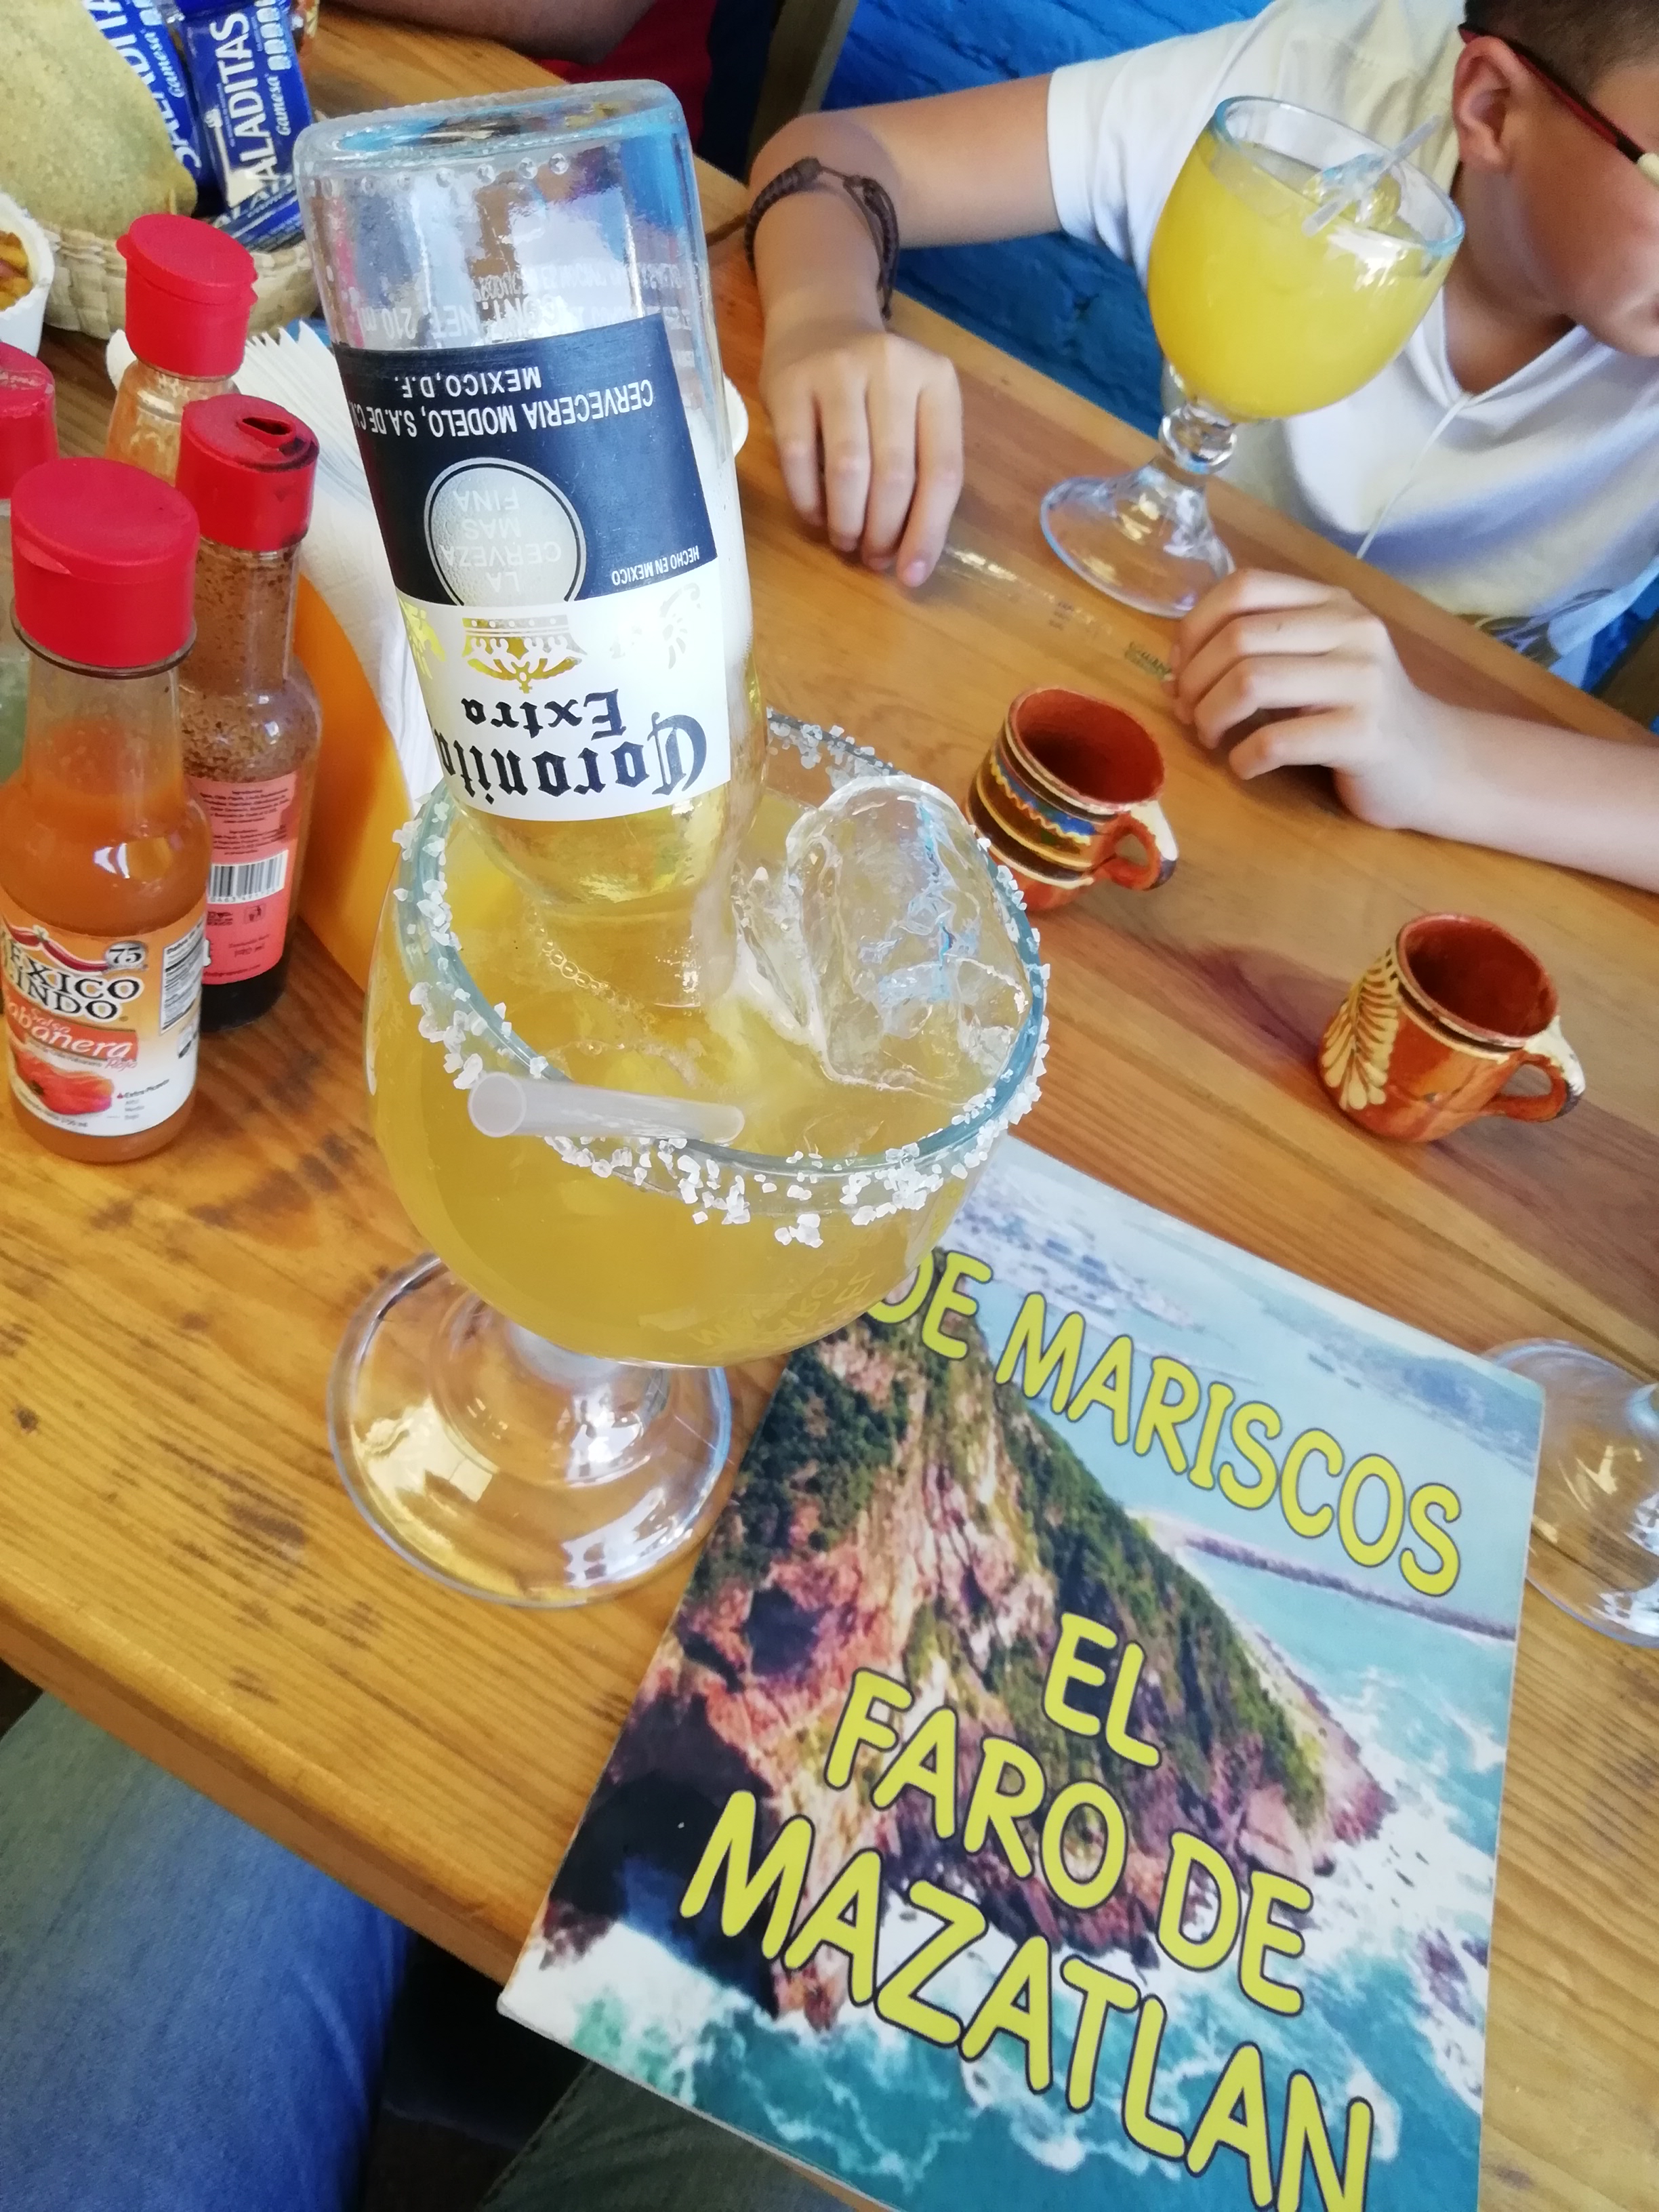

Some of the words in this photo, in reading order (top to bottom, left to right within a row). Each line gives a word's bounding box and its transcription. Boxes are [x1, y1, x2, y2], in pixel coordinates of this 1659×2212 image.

[209, 12, 280, 194] ALADITAS
[266, 74, 291, 136] Gamesa
[381, 307, 417, 340] 210
[367, 406, 387, 435] DE
[384, 409, 418, 438] S.A.
[421, 405, 518, 438] MODELO,
[522, 379, 654, 430] CERVECERIA
[453, 486, 520, 512] FINA
[462, 518, 521, 541] MAS
[441, 541, 562, 568] CERVEZA
[611, 562, 654, 586] MEXICO
[654, 557, 669, 575] EN
[670, 545, 700, 570] HECHO
[487, 571, 520, 594] LA
[461, 689, 628, 741] Extra
[434, 712, 708, 805] Coronita
[9, 939, 140, 1000] EXICO
[108, 946, 142, 964] 75
[16, 965, 118, 1020] INDO
[8, 1002, 134, 1059] abanera
[994, 1292, 1462, 1597] MARISCOS
[1042, 1611, 1163, 1769] EL
[823, 1667, 1128, 1910] FARO
[1155, 1828, 1314, 2017] DE
[678, 1789, 1374, 2212] MAZATLAN
